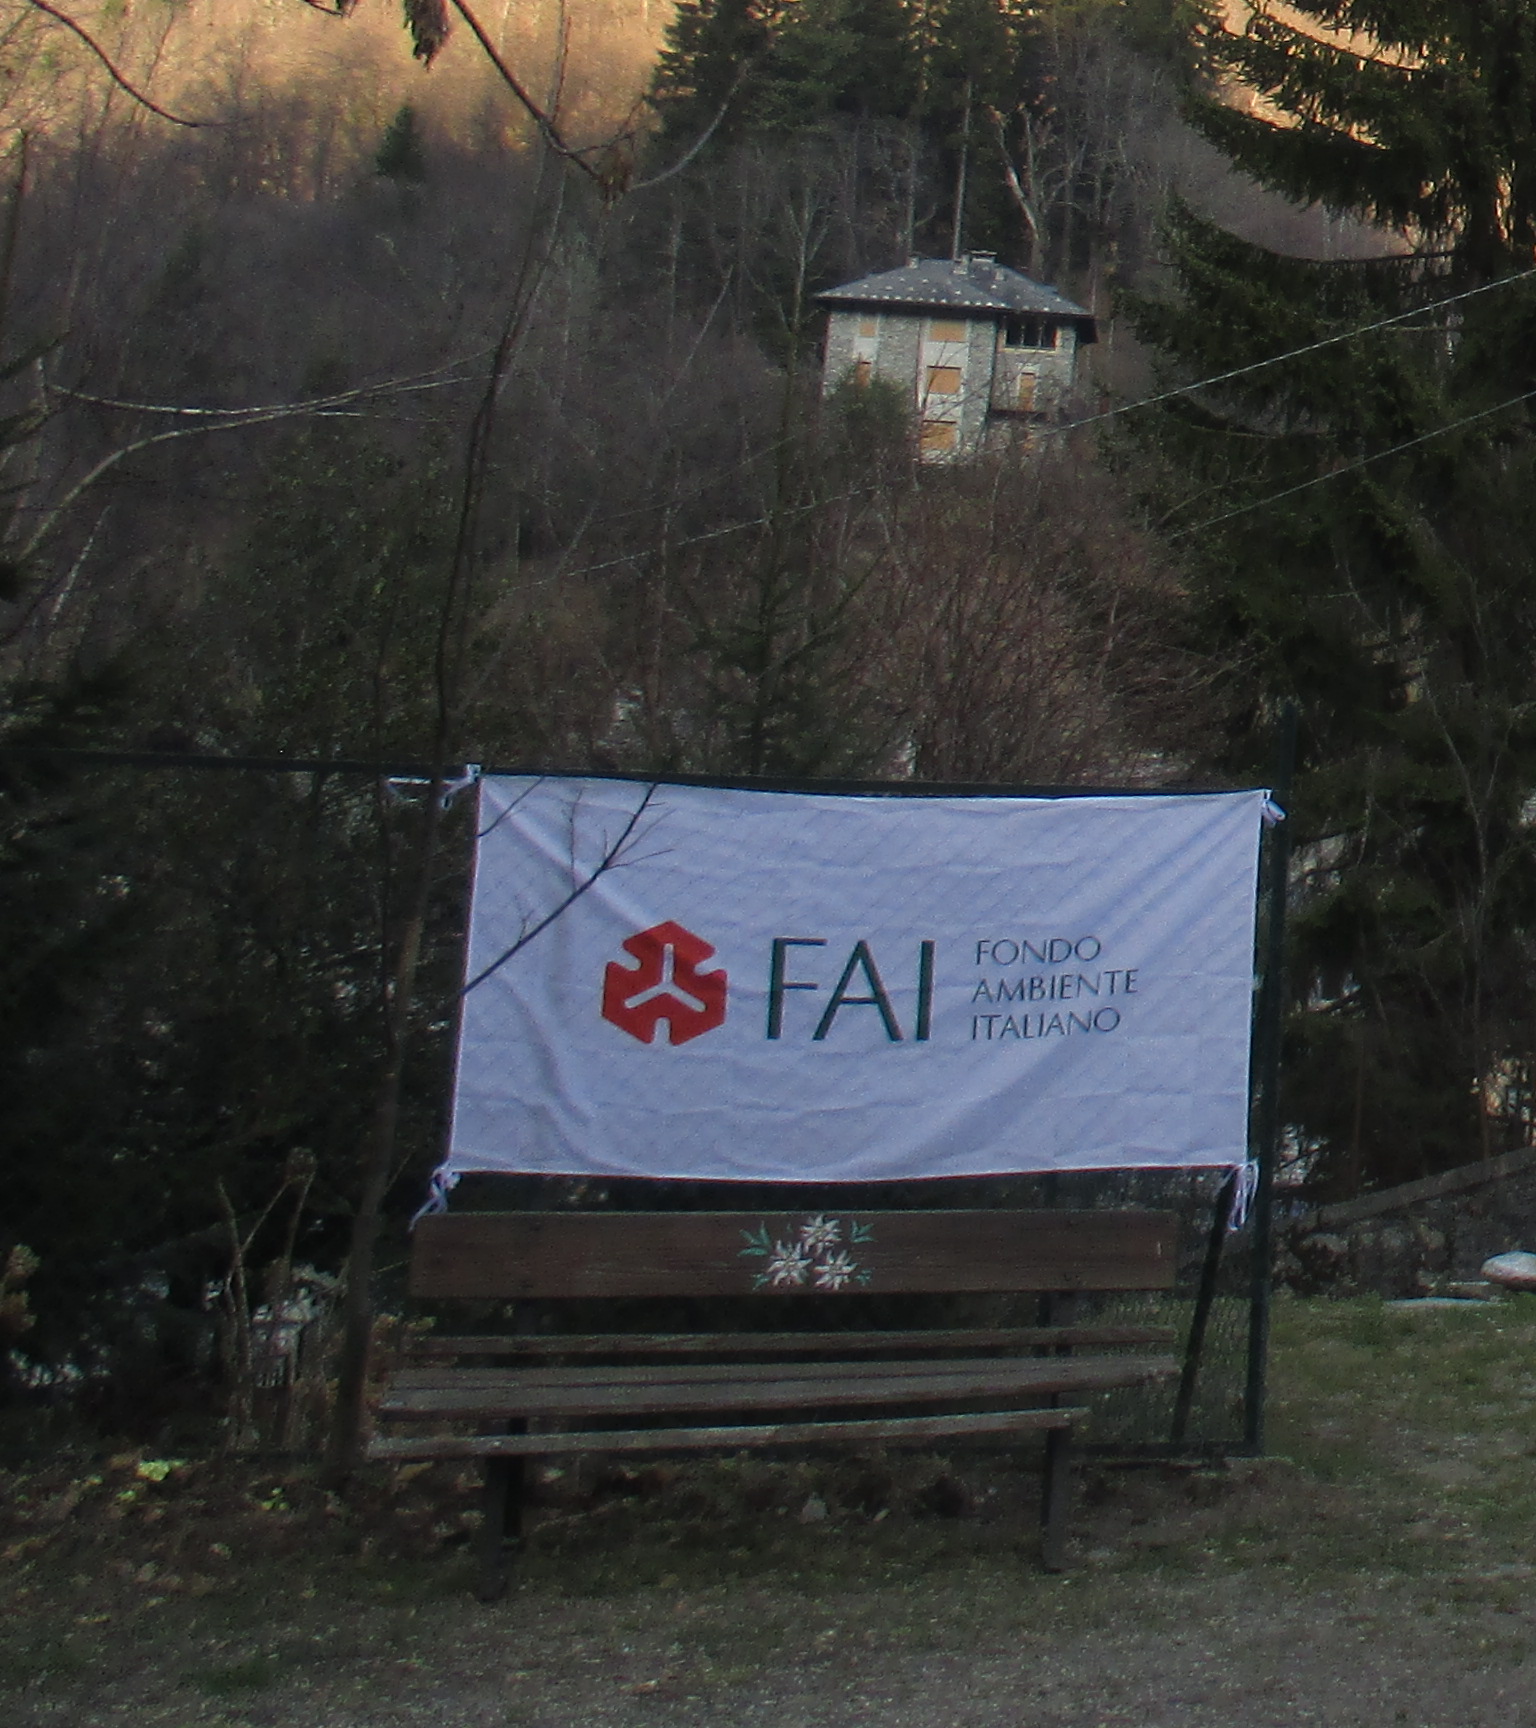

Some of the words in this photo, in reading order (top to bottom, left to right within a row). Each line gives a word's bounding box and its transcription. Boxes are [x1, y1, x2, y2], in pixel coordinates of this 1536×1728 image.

[975, 935, 1102, 966] FONDO
[766, 936, 935, 1043] FAI
[971, 969, 1139, 1004] AMBIENTE
[971, 1007, 1122, 1041] ITALIANO
